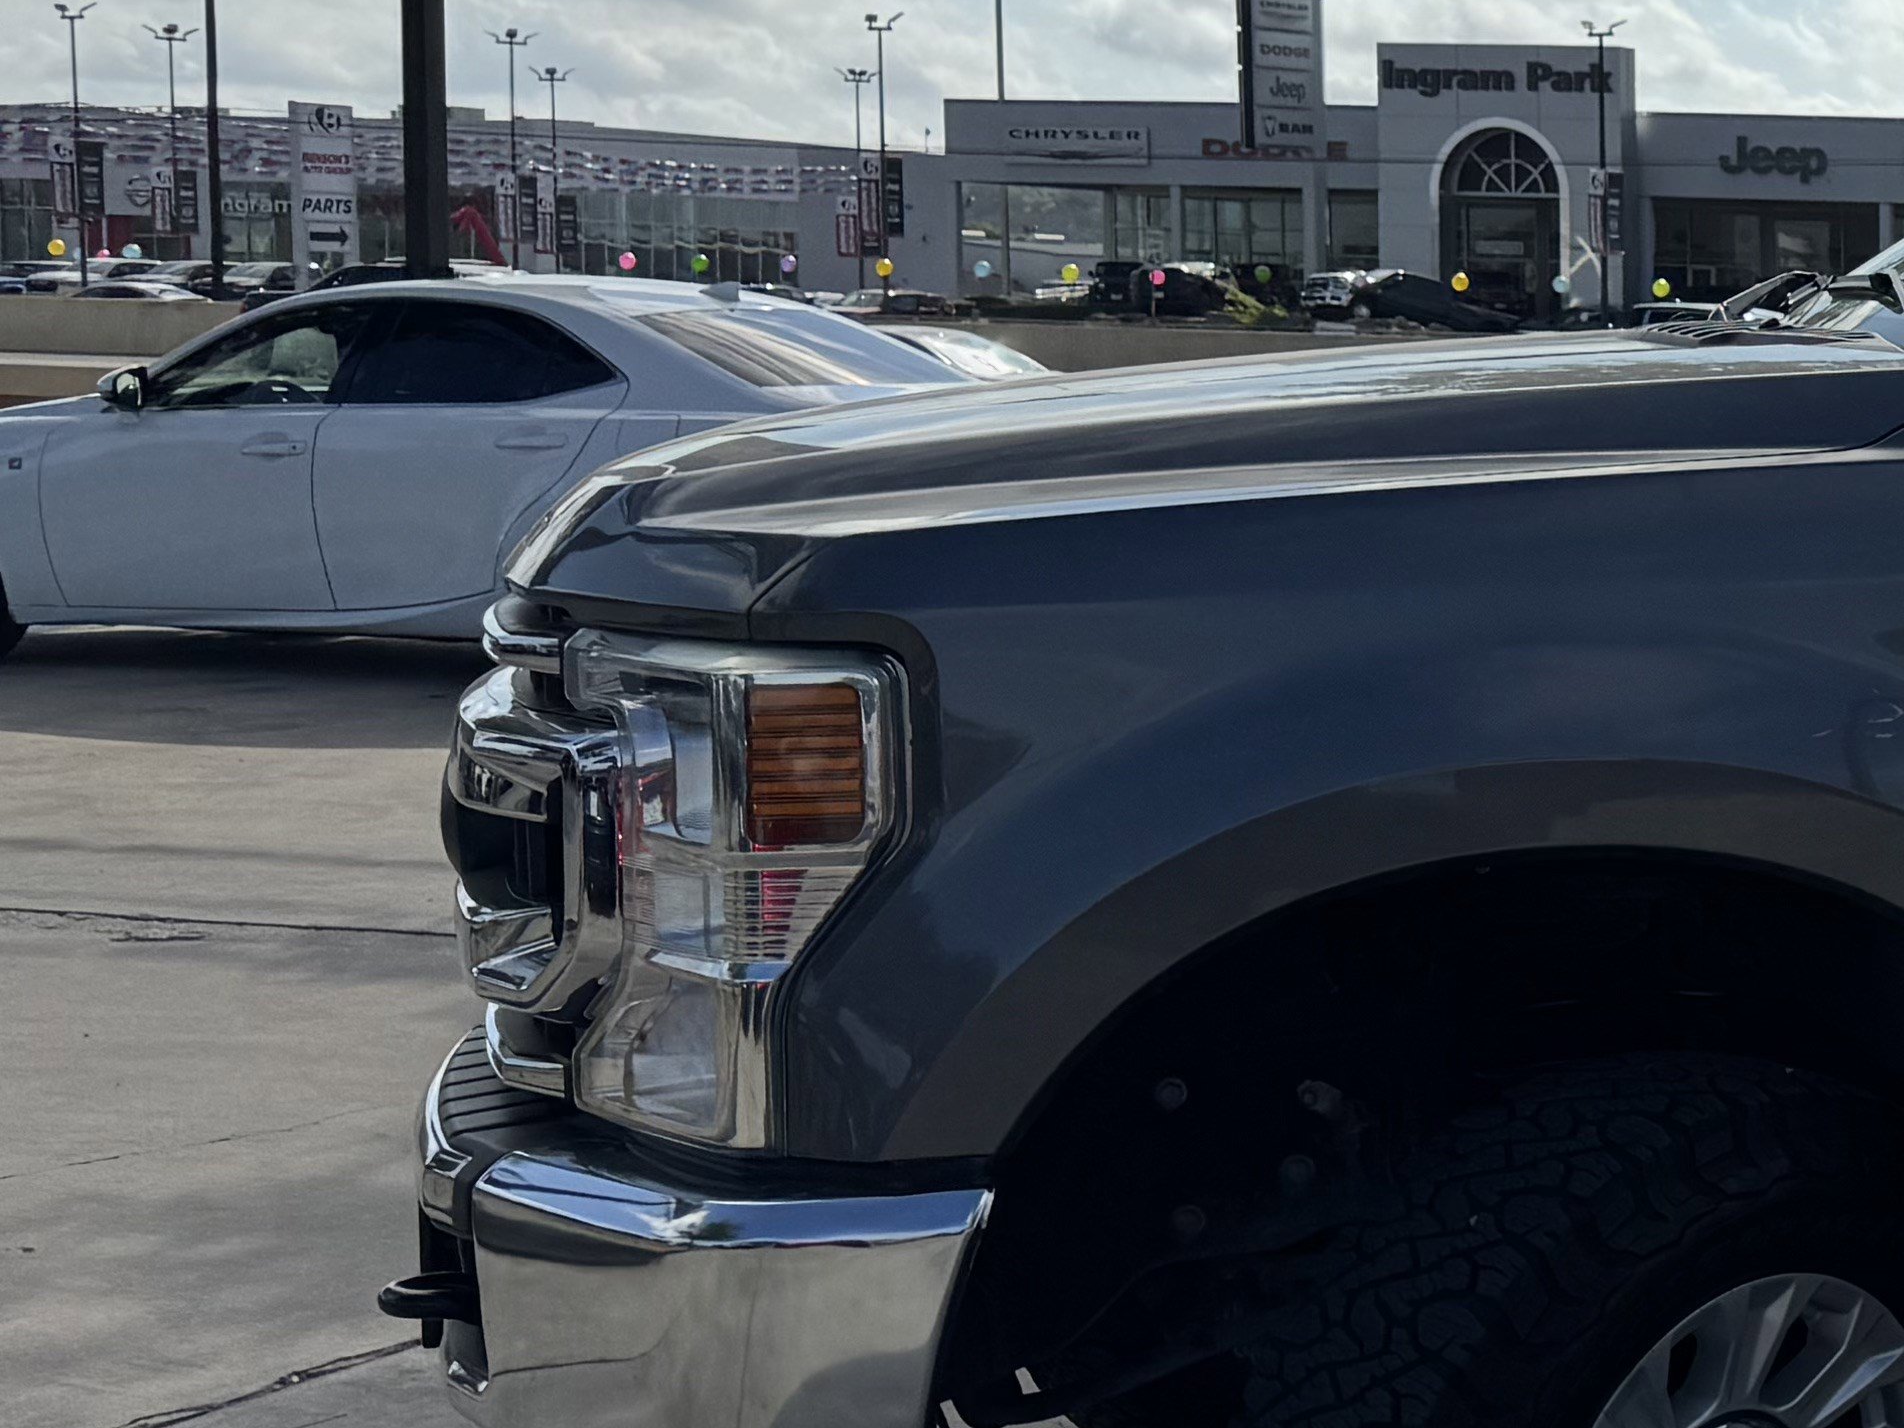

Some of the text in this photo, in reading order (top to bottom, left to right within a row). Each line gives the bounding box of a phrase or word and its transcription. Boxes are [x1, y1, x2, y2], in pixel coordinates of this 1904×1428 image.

[1259, 42, 1311, 59] DODGE
[1381, 58, 1614, 98] Ingram Park
[1269, 75, 1306, 103] Jeep
[1008, 128, 1141, 141] CHRYSLER
[1278, 122, 1314, 135] RAM
[1718, 135, 1829, 185] Jeep
[302, 197, 353, 215] PARTS
